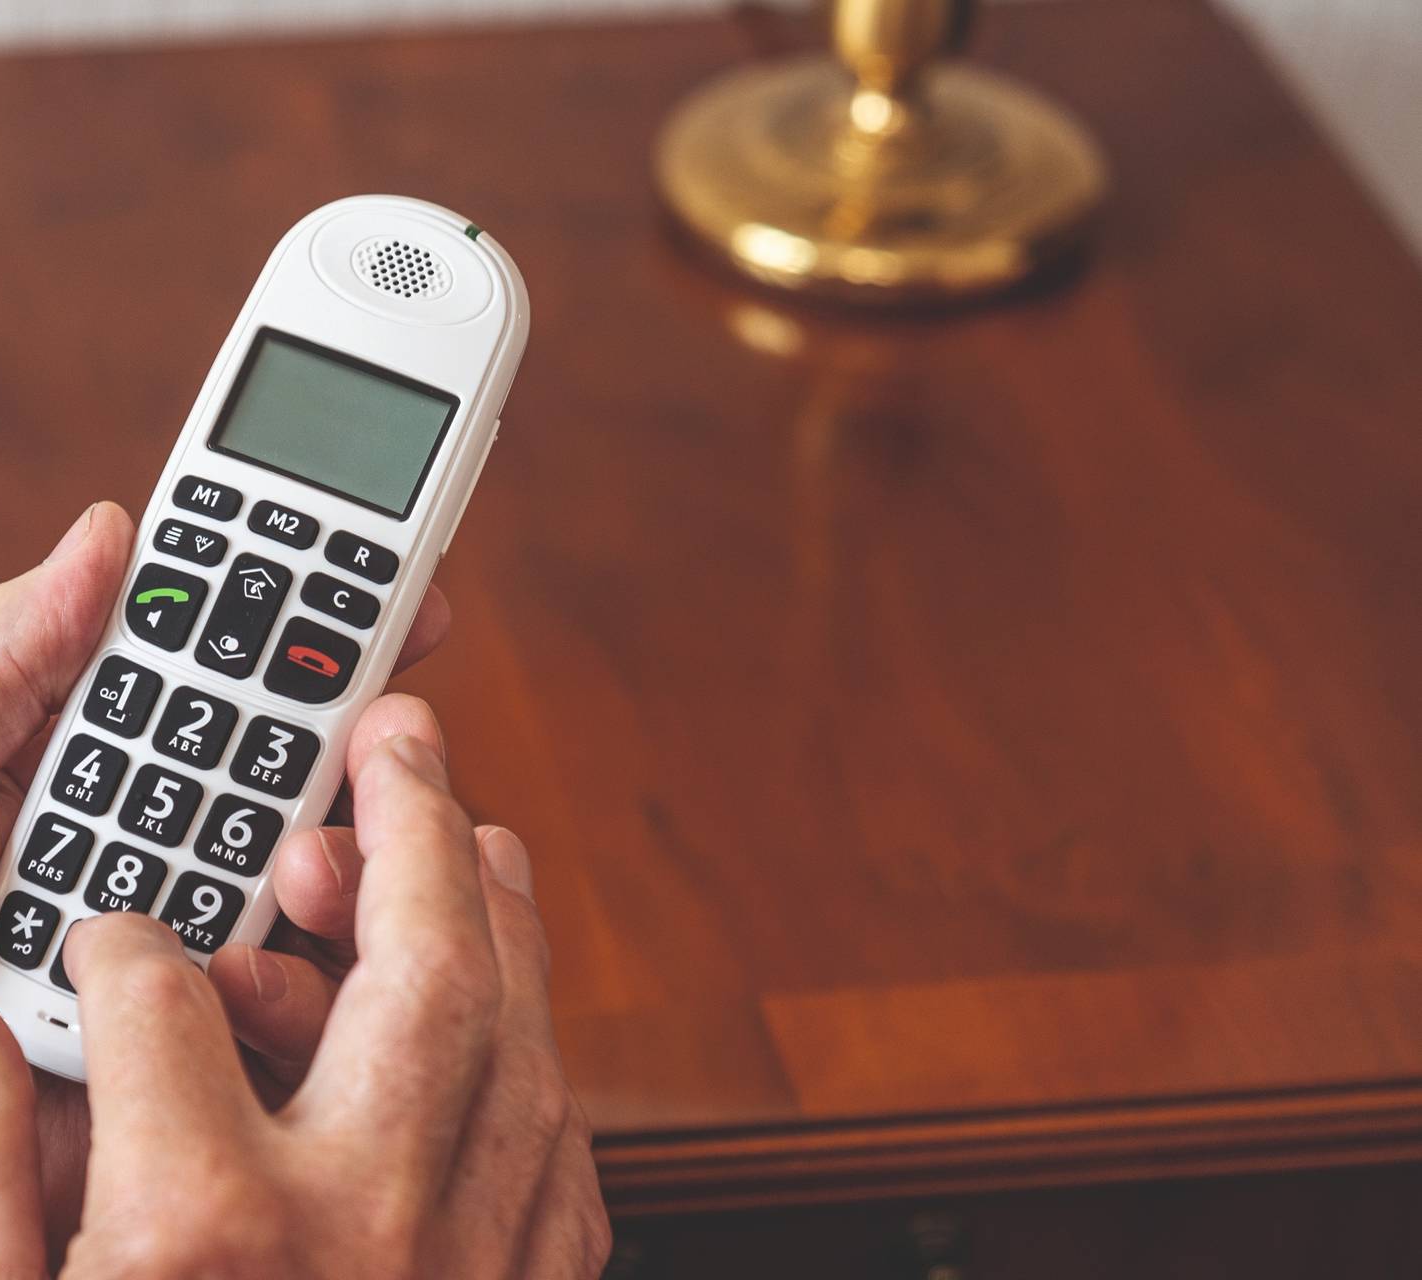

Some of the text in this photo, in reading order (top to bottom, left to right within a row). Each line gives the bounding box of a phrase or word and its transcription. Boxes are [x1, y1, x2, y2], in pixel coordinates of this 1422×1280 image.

[191, 485, 221, 508] M1
[266, 510, 300, 536] M2
[354, 546, 371, 567] R
[334, 591, 350, 609] C
[116, 672, 139, 710] 1
[177, 700, 214, 744] 2
[168, 735, 202, 758] ABC
[257, 726, 295, 770] 3
[72, 748, 102, 790] 4
[250, 764, 283, 786] DEF
[65, 783, 94, 803] GHI
[144, 776, 182, 820] 5
[136, 814, 164, 836] JKL
[222, 808, 257, 849] 6
[41, 823, 78, 864] 7
[209, 842, 248, 866] MNO
[27, 859, 64, 882] PQRS
[107, 854, 144, 897] 8
[188, 885, 223, 926] 9
[171, 918, 215, 946] WXYZ
